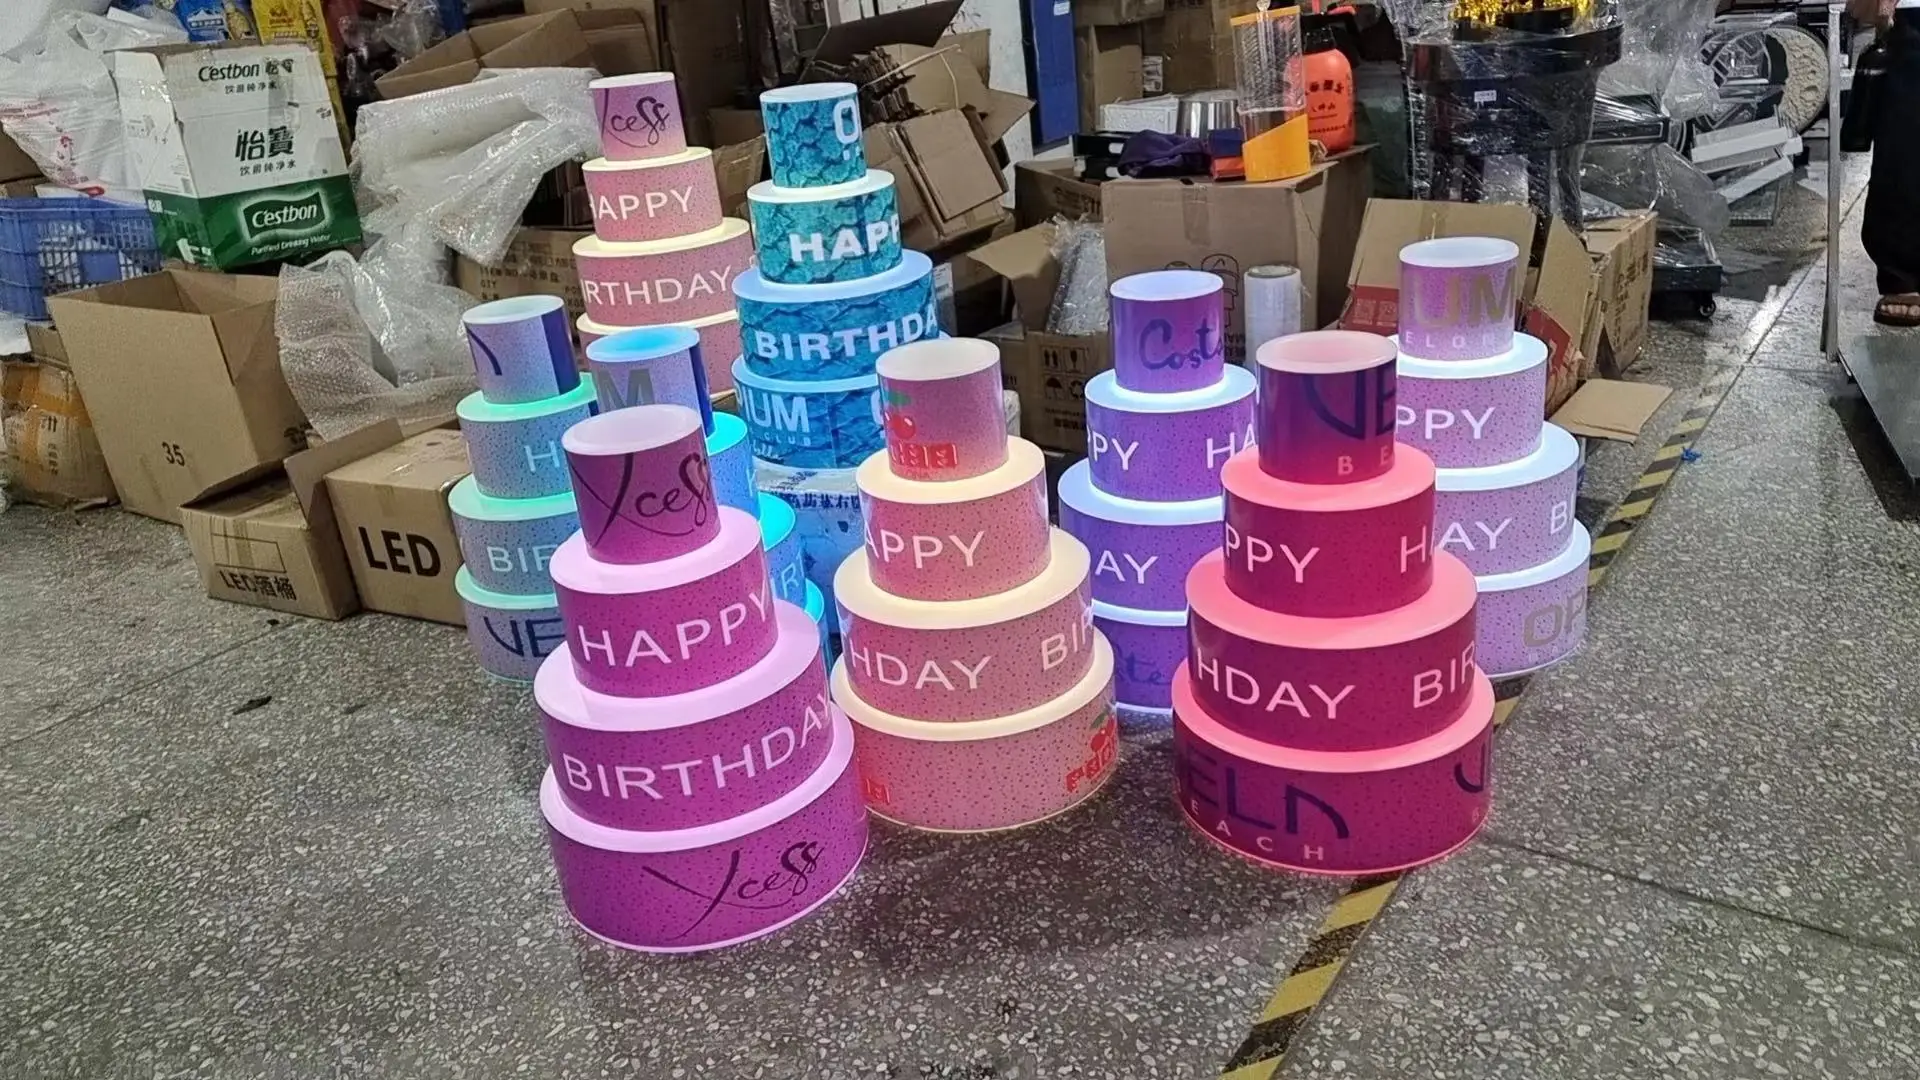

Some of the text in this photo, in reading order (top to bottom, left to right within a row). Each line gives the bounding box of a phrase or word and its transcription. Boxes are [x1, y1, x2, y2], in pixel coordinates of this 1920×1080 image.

[162, 441, 185, 466] 35
[358, 526, 441, 577] LED
[577, 575, 769, 668] HAPPY
